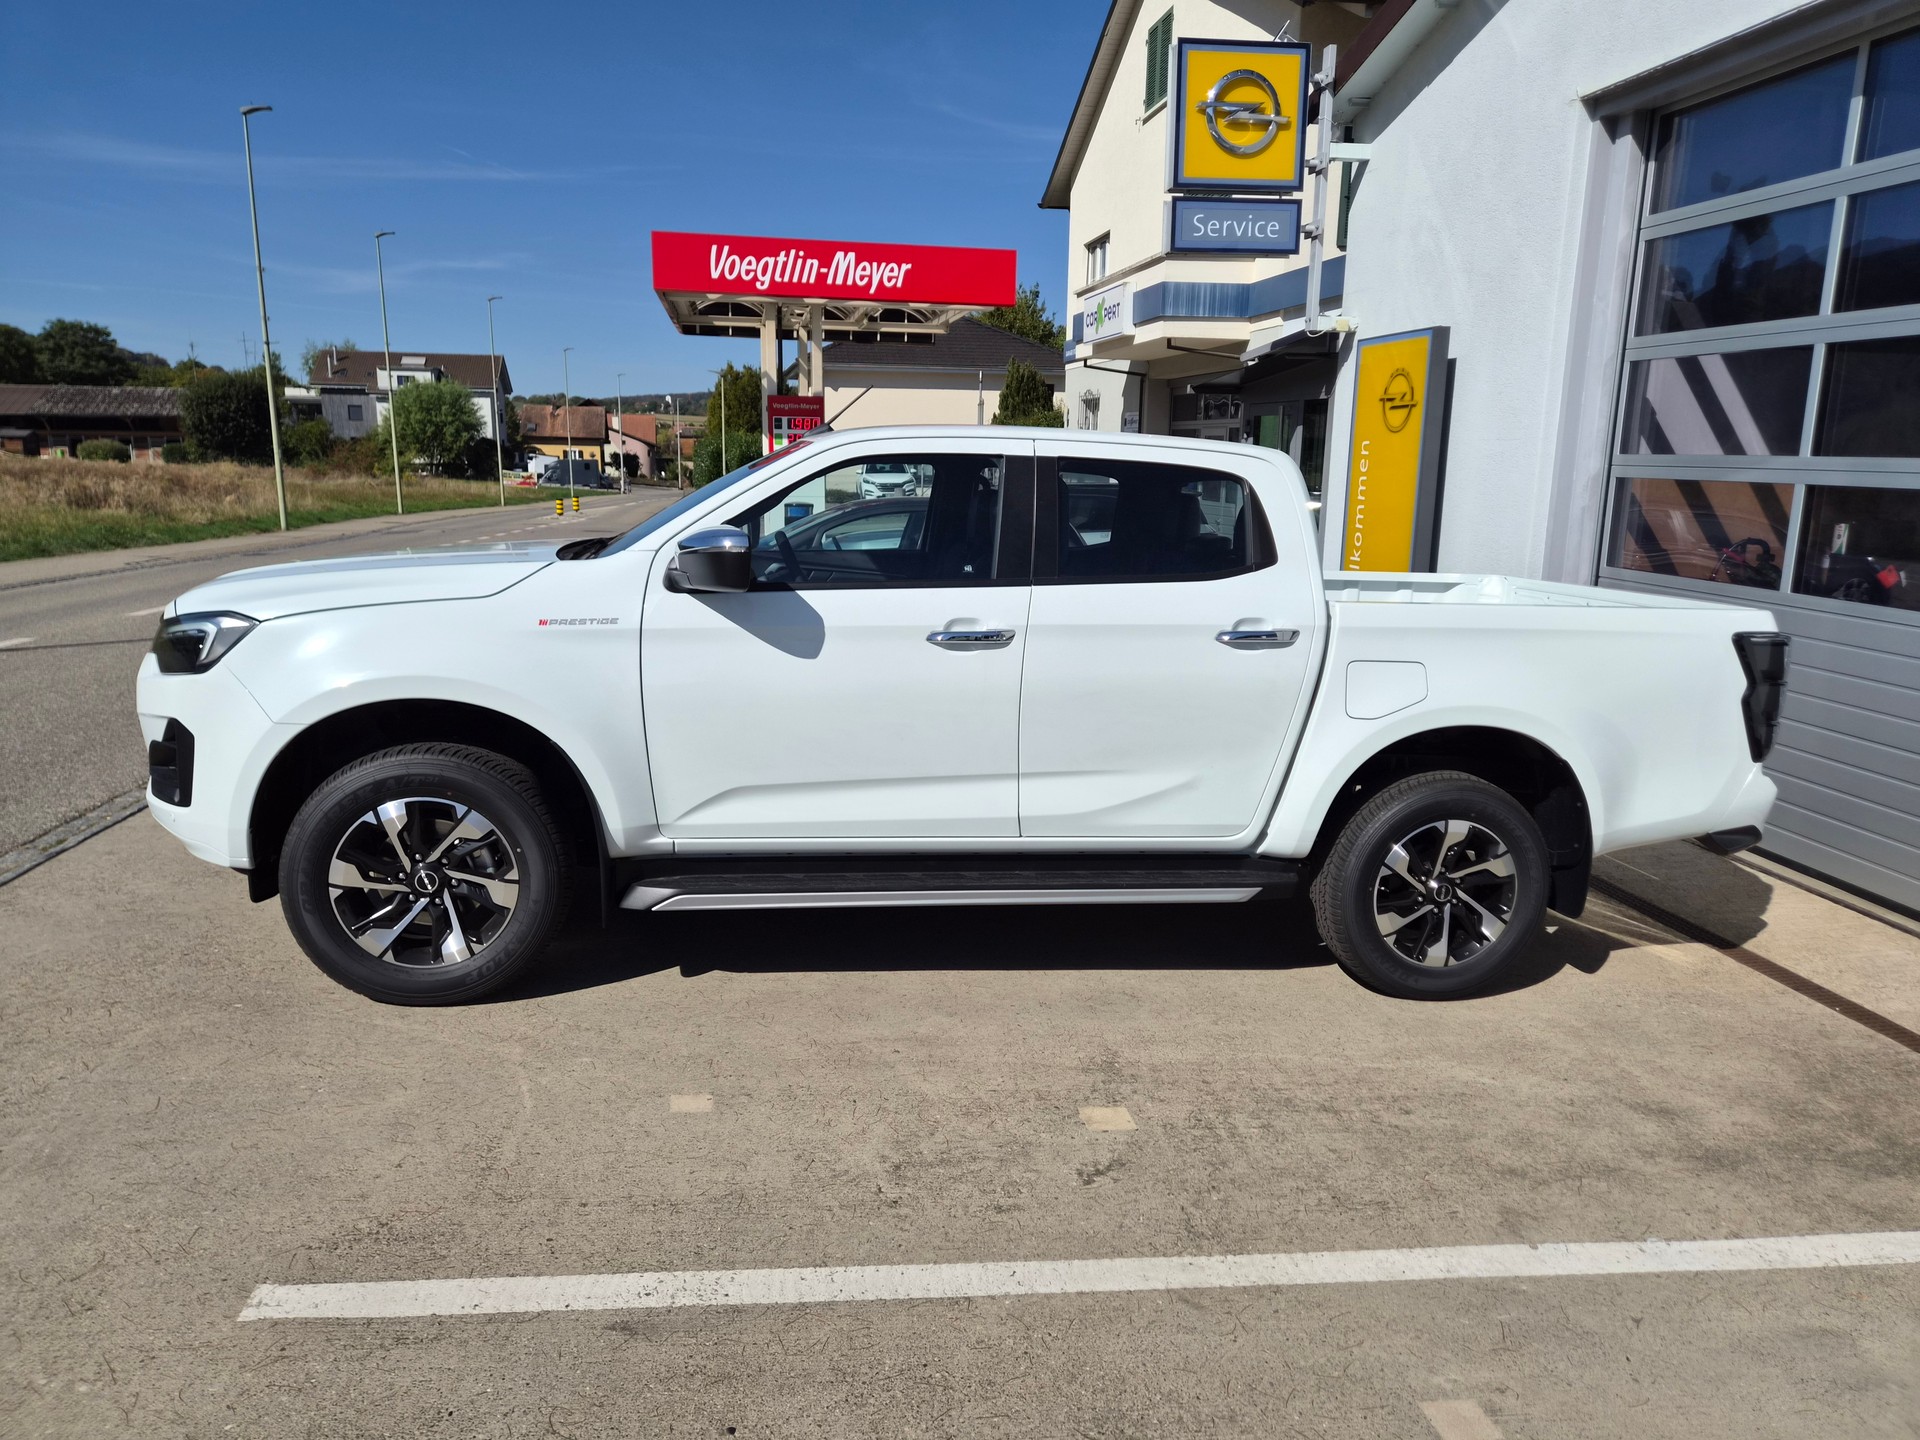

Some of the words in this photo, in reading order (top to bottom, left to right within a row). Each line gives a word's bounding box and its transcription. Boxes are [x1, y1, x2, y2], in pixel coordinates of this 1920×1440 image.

[1193, 214, 1280, 238] Service
[710, 244, 912, 294] Voegtlin-Meyer
[548, 617, 619, 626] PRESTIGE
